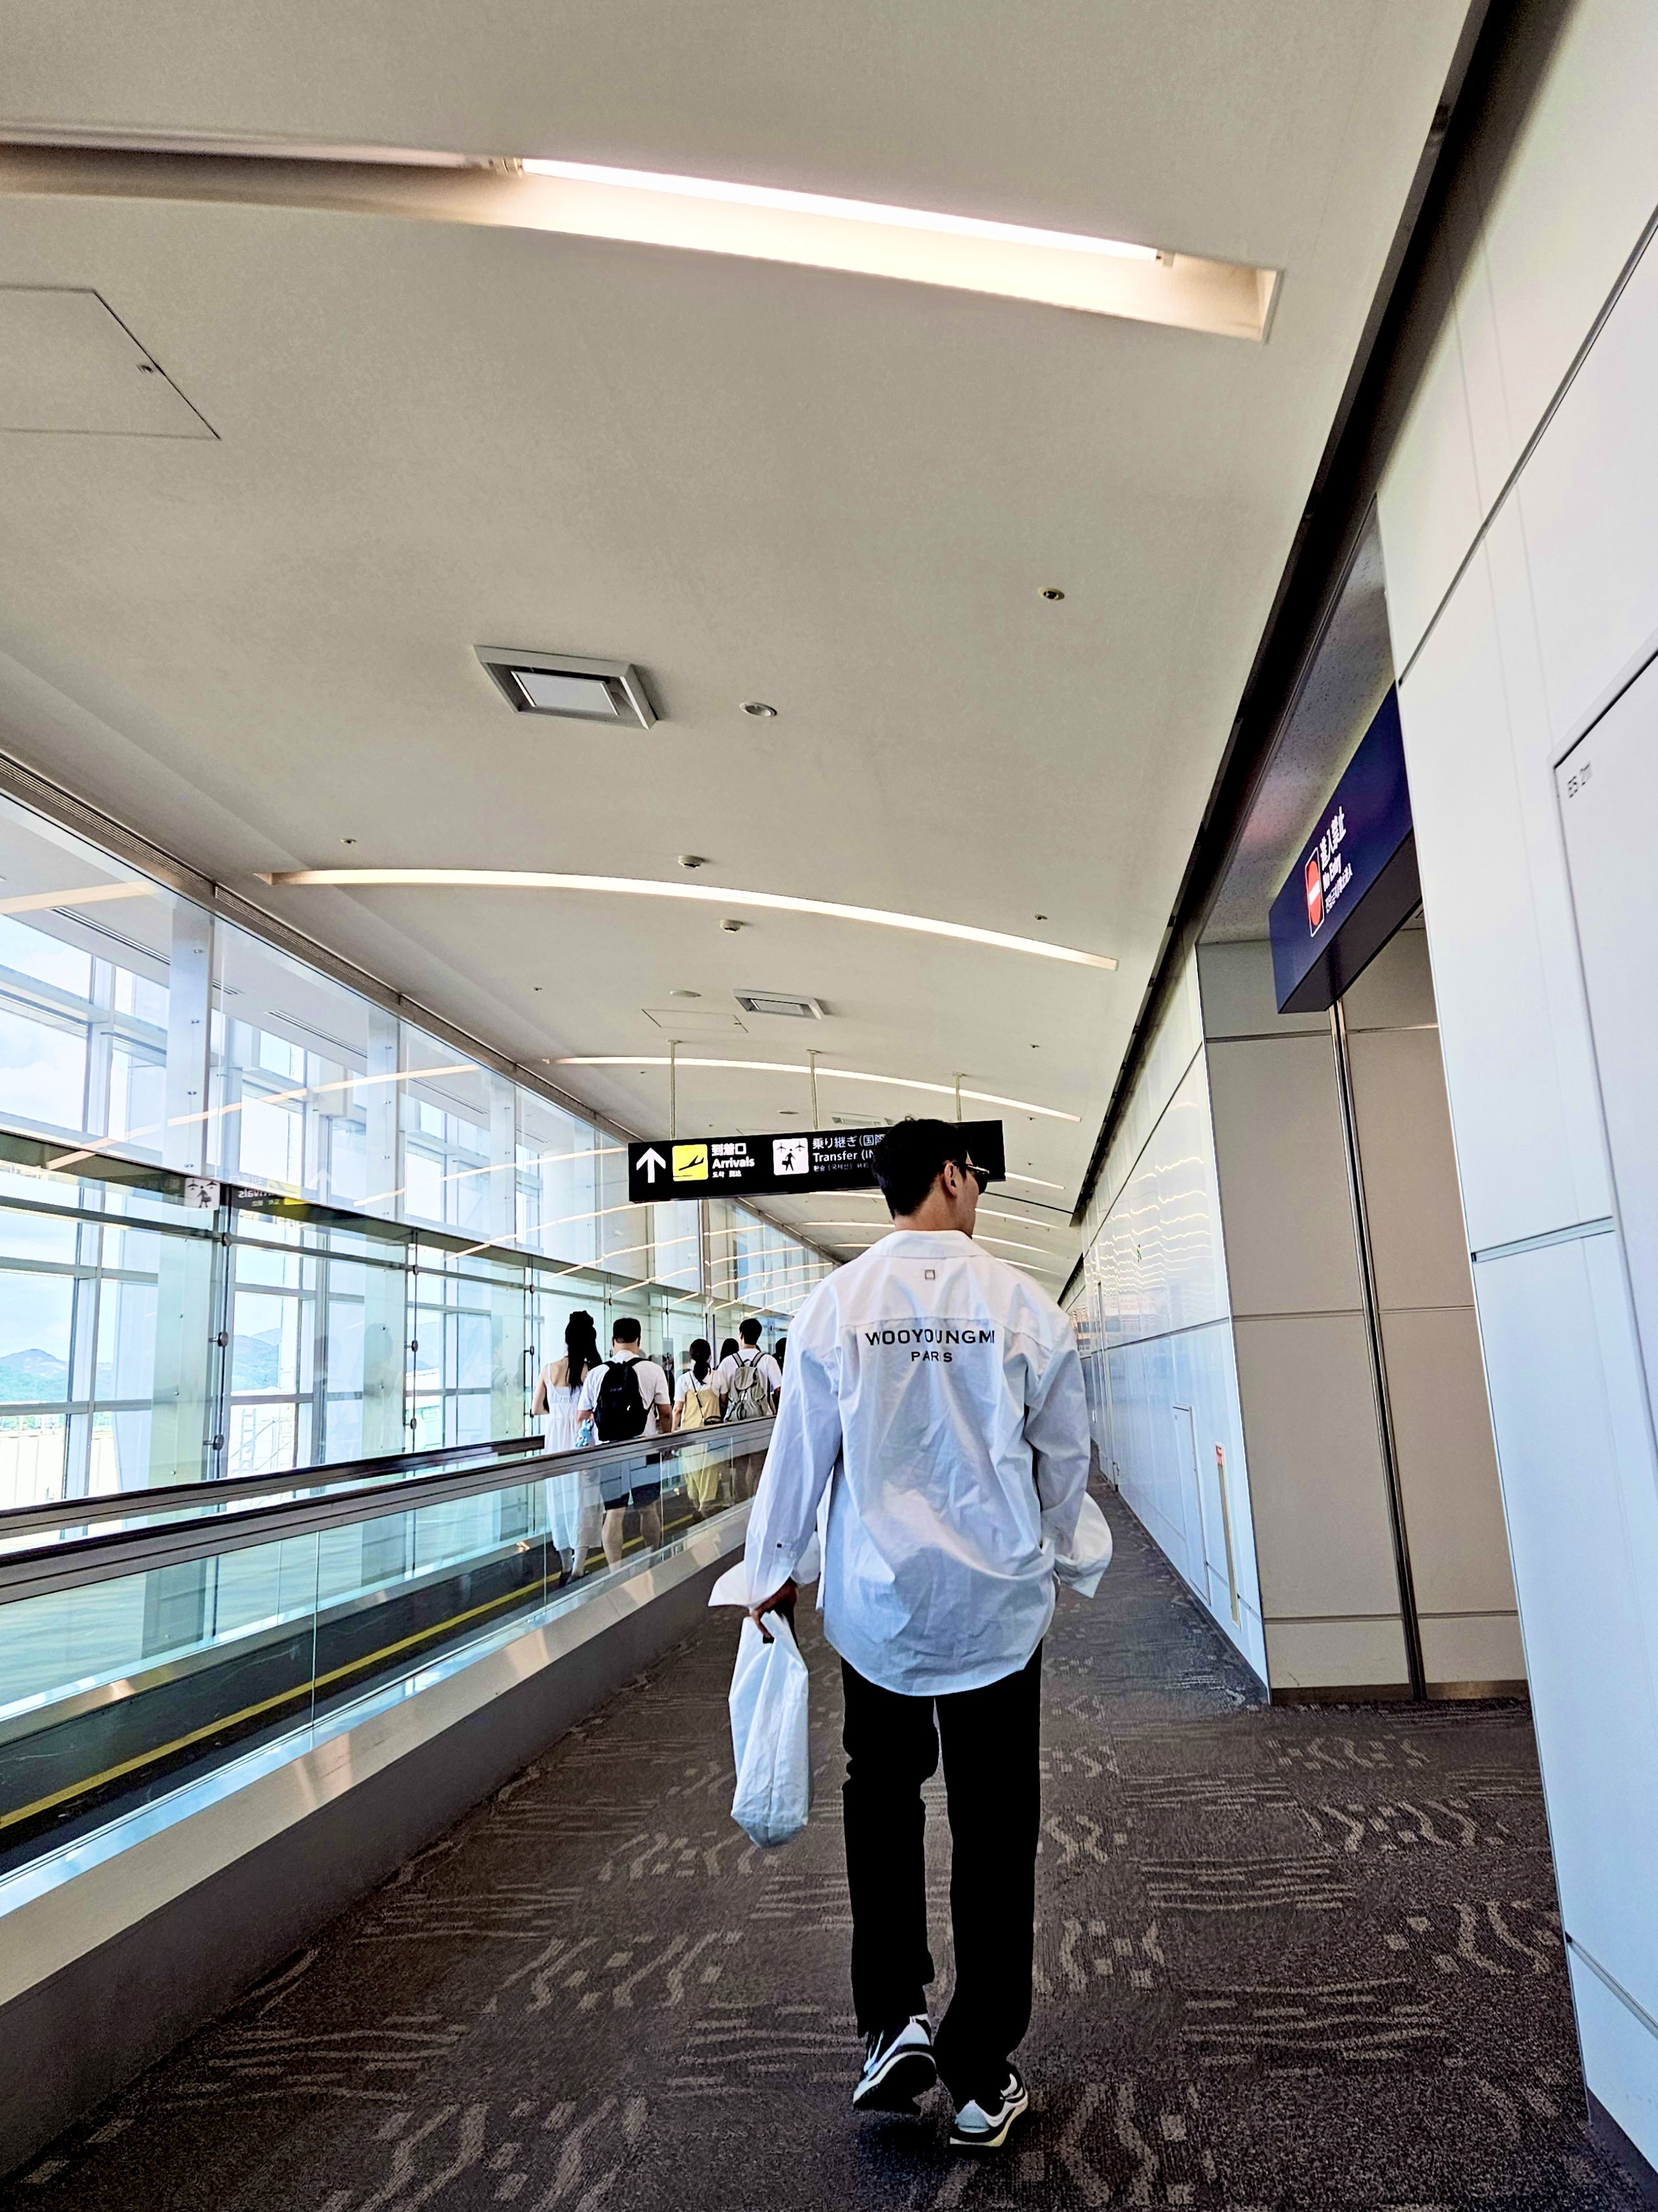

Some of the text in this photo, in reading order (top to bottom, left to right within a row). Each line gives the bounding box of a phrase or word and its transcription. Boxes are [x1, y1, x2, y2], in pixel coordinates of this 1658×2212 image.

[711, 1143, 747, 1156] 到着口
[813, 1150, 858, 1162] Transfer
[712, 1156, 755, 1169] Arrivals
[865, 1329, 995, 1345] WOOYOUNGMI
[911, 1351, 953, 1362] PARS
